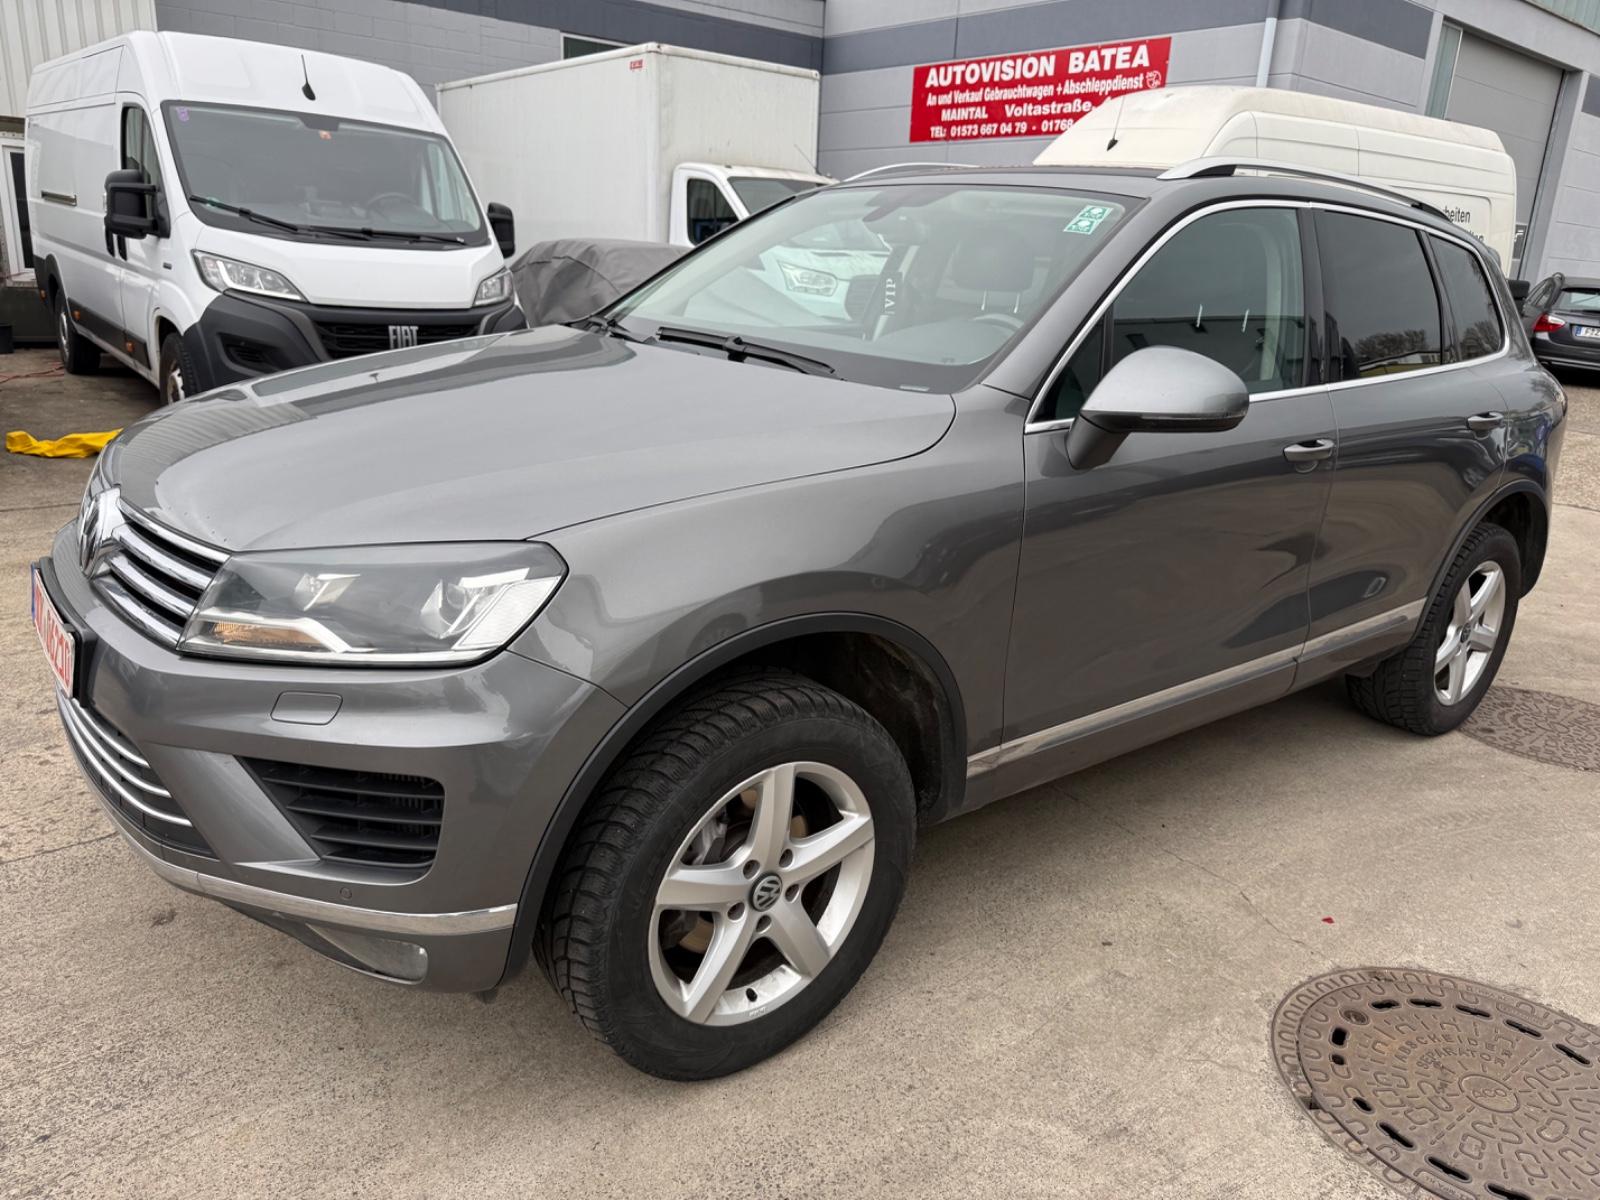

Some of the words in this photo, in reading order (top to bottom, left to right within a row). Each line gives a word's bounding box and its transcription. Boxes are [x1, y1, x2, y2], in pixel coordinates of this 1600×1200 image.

[925, 55, 1056, 88] AUTOVISION
[1068, 44, 1150, 74] BATEA
[926, 92, 937, 107] An
[938, 90, 953, 105] und
[954, 87, 983, 104] Verkauf
[984, 81, 1054, 101] Gebrauchtwagen
[1063, 73, 1144, 95] Abschleppdienst
[941, 106, 988, 122] MAINTAL
[1005, 98, 1092, 117] Voltastraße
[930, 126, 947, 138] TEL:
[950, 124, 979, 137] 01573
[980, 123, 999, 136] 667
[1000, 122, 1012, 134] 04
[1014, 121, 1028, 133] 79
[884, 278, 896, 308] VIP
[388, 325, 419, 350] FIAT
[1395, 1033, 1513, 1064] ABSCHEIDER
[1415, 1046, 1506, 1070] SEPARATOR
